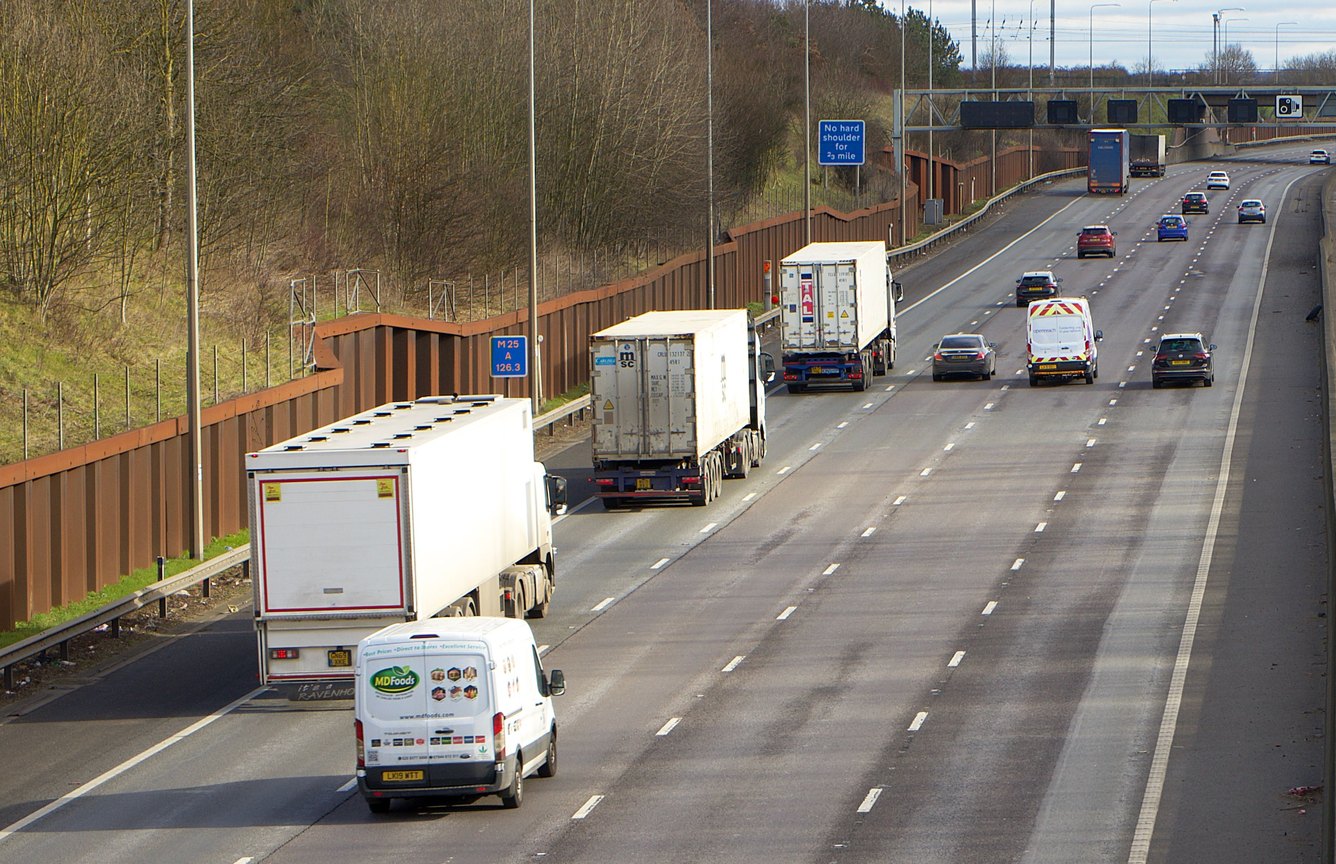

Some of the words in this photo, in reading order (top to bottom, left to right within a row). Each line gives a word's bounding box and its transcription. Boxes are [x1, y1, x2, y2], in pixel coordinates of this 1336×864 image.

[824, 124, 838, 132] No
[840, 124, 860, 132] hard
[837, 152, 856, 160] mile
[801, 281, 813, 315] TAL
[505, 352, 511, 360] A
[496, 363, 520, 372] 126.3
[374, 675, 416, 687] MDFoods
